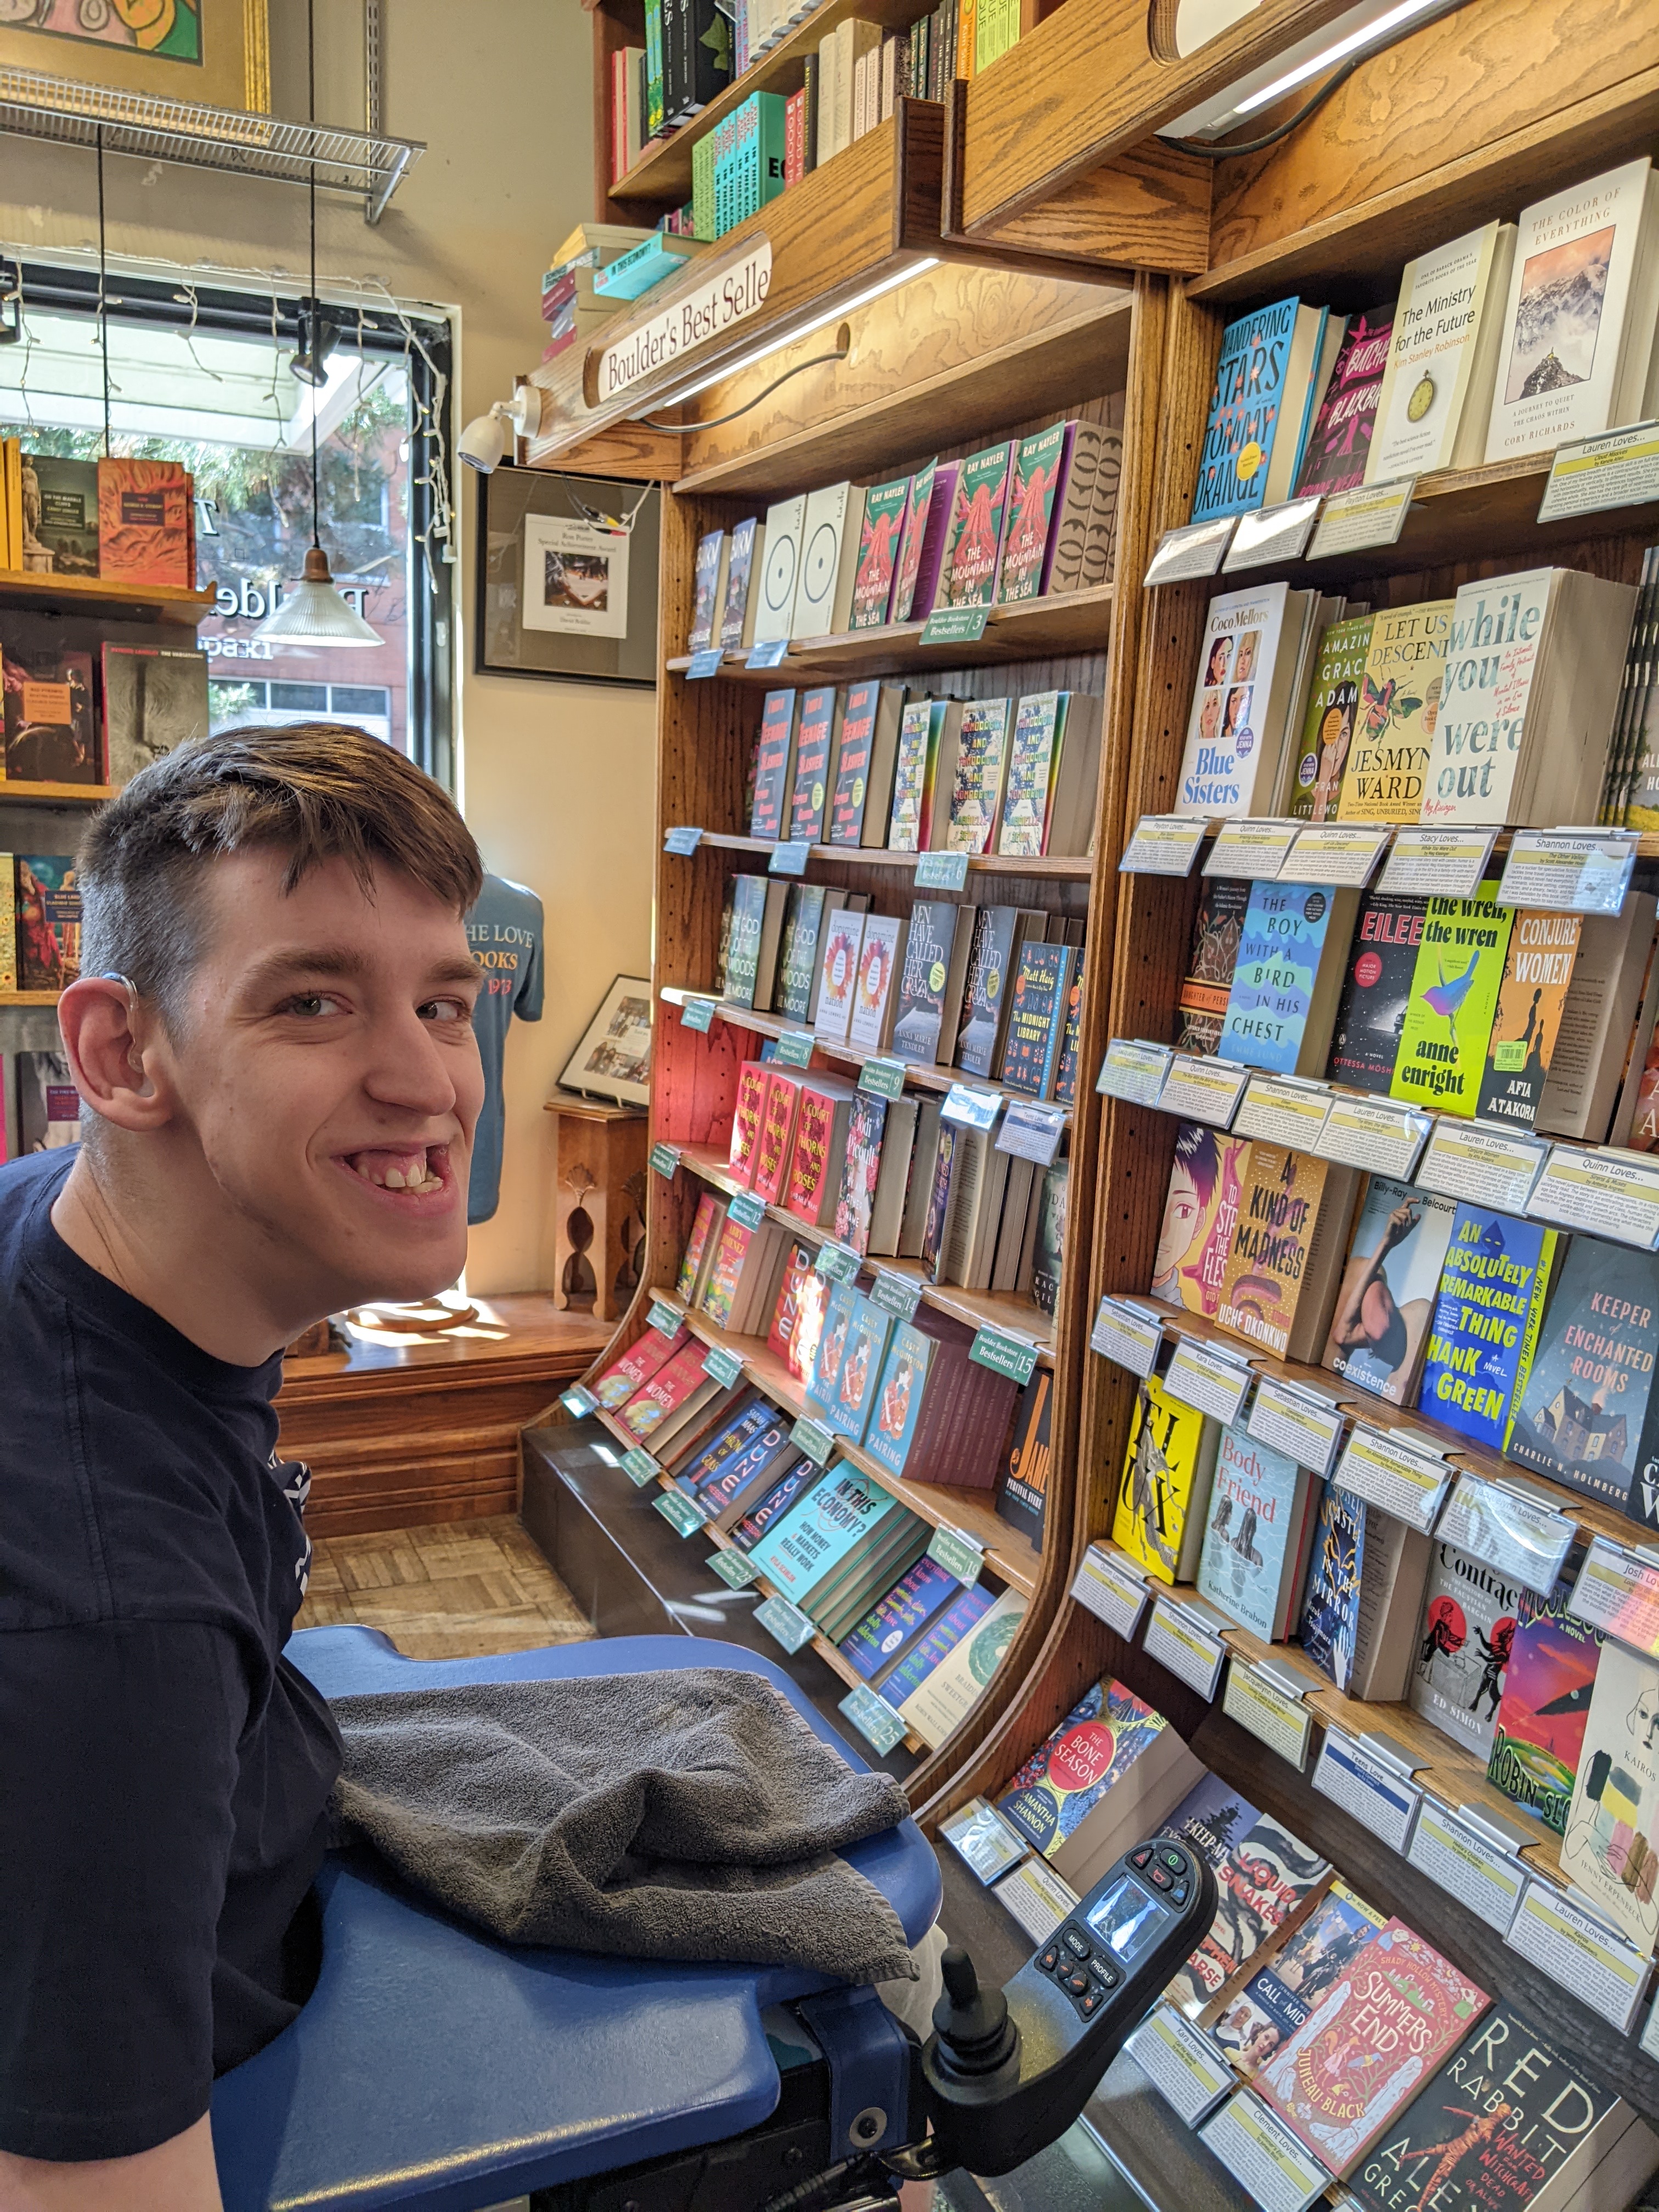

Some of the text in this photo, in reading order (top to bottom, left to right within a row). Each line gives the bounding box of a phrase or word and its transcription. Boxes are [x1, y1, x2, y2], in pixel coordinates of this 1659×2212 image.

[1532, 188, 1621, 232] THE COLOR OF
[1535, 208, 1611, 245] EVERYTHING
[1436, 262, 1453, 272] BARACK
[1454, 253, 1472, 264] OBAMA'S
[1415, 278, 1434, 289] FAVORITE
[1435, 271, 1448, 280] BOOKS
[1402, 285, 1476, 326] The Ministry
[609, 261, 772, 391] Boulder's Best Selle
[1222, 304, 1291, 362] WANDERING
[1394, 311, 1475, 353] for the Future
[1393, 334, 1470, 370] Kim Stanley Robinson
[1211, 341, 1283, 412] STARS
[1023, 431, 1059, 458] RAY NAYLER
[1202, 404, 1276, 465] TOMMY
[1505, 421, 1575, 446] CORY RICHARDS
[1582, 434, 1645, 454] Lauren Loves...
[1021, 532, 1034, 547] THE
[1004, 544, 1044, 570] MOUNTAIN
[1018, 567, 1026, 581] IN
[1005, 581, 1032, 602] THE SEA
[930, 614, 980, 636] Bestsellers 3
[1211, 608, 1269, 633] Coco Mellors
[1385, 614, 1447, 641] LET US
[1448, 592, 1540, 654] while
[1439, 653, 1497, 711] you
[972, 739, 986, 748] AND
[1444, 715, 1524, 756] were
[1195, 746, 1234, 775] Blue
[969, 772, 983, 782] AND
[1183, 776, 1240, 804] Sisters
[1357, 776, 1421, 800] WARD
[1437, 756, 1496, 798] out
[956, 789, 995, 800] TOMORROW
[1420, 834, 1438, 843] Stacy
[1536, 838, 1603, 851] Shannon Loves...
[911, 905, 932, 923] MEN
[1263, 898, 1286, 911] THE
[1429, 897, 1507, 922] the wren,
[465, 924, 534, 949] HE LOVE
[831, 920, 859, 936] dopamine
[909, 923, 934, 943] HAVE
[1267, 918, 1302, 936] BOY
[1426, 922, 1497, 947] the wren
[1520, 918, 1580, 946] CONJURE
[471, 951, 518, 969] OOKS
[906, 943, 943, 963] CALLED
[1246, 943, 1291, 960] WITH A
[781, 969, 810, 989] WOODS
[904, 958, 922, 978] HER
[1022, 966, 1054, 990] Matt Haig
[1254, 968, 1295, 988] BIRD
[1516, 952, 1572, 984] WOMEN
[488, 979, 512, 995] 1973
[901, 977, 928, 998] CRAZY
[825, 996, 843, 1008] nation
[1256, 994, 1300, 1014] IN HIS
[1017, 1026, 1041, 1041] LIBRARY
[1022, 1013, 1050, 1028] MIDNIGHT
[1232, 1017, 1284, 1041] CHEST
[1416, 1039, 1459, 1065] anne
[1401, 1065, 1465, 1096] enright
[1506, 1080, 1532, 1098] AFIA
[803, 1103, 830, 1121] A COURT
[1487, 1099, 1536, 1122] ATAKORA
[805, 1121, 811, 1131] OF
[856, 1114, 871, 1137] Jodi
[798, 1136, 826, 1158] THORNS
[848, 1137, 874, 1167] Picoult
[810, 1161, 821, 1172] AND
[1280, 1152, 1292, 1183] A
[793, 1172, 816, 1190] ROSES
[1250, 1186, 1310, 1234] KIND OF
[1374, 1181, 1457, 1215] Billy-Ray Belcourt
[1458, 1221, 1482, 1244] AN
[1235, 1225, 1305, 1279] MADNESS
[1446, 1247, 1533, 1287] ABSOLUTELY
[1440, 1274, 1527, 1315] REMARKABLE
[1591, 1292, 1651, 1328] KEEPER
[1218, 1304, 1287, 1352] UCHE OKONKWO
[1459, 1306, 1517, 1348] THING
[892, 1345, 924, 1372] McQUISTON
[902, 1338, 920, 1353] CASEY
[979, 1335, 1018, 1357] Boulder Bookstore
[1427, 1335, 1482, 1375] HANK
[1565, 1325, 1653, 1372] ENCHANTED
[979, 1346, 1033, 1374] Bestsellers 15
[664, 1380, 675, 1392] THE
[1333, 1357, 1397, 1396] coexistence
[1572, 1357, 1628, 1392] ROOMS
[646, 1380, 675, 1409] WOMEN
[1437, 1374, 1505, 1420] GREEN
[883, 1432, 892, 1442] THE
[868, 1438, 901, 1466] PAIRING
[1222, 1436, 1266, 1486] Body
[1370, 1439, 1424, 1469] Shannon Loves...
[834, 1478, 876, 1515] IN THIS
[1217, 1470, 1276, 1523] Friend
[811, 1487, 867, 1538] ECONOMY?
[797, 1537, 821, 1560] MARKETS
[799, 1521, 831, 1551] HOW MONEY
[781, 1539, 815, 1572] REALLY WORK
[1208, 1579, 1267, 1628] Katherine Brabon
[1071, 1735, 1104, 1766] BONE
[1090, 1732, 1103, 1747] THE
[1055, 1745, 1096, 1784] SEASON
[1624, 1751, 1656, 1782] KAIROS
[1013, 1800, 1046, 1833] SHANNON
[1019, 1790, 1055, 1825] SAMANTHA
[1239, 1853, 1297, 1905] LIQUID
[1581, 1859, 1641, 1925] JENNY ERPENBECK
[1218, 1865, 1283, 1926] SNAKES
[1069, 1935, 1084, 1951] MODE
[1091, 1960, 1113, 1983] PROFILE
[1381, 1957, 1448, 2017] SHADY HOLLOW MYSTERY
[1353, 1972, 1433, 2052] SUMMERS
[1351, 2004, 1399, 2052] END
[1468, 2018, 1594, 2132] RED
[1447, 2057, 1567, 2162] RABBIT
